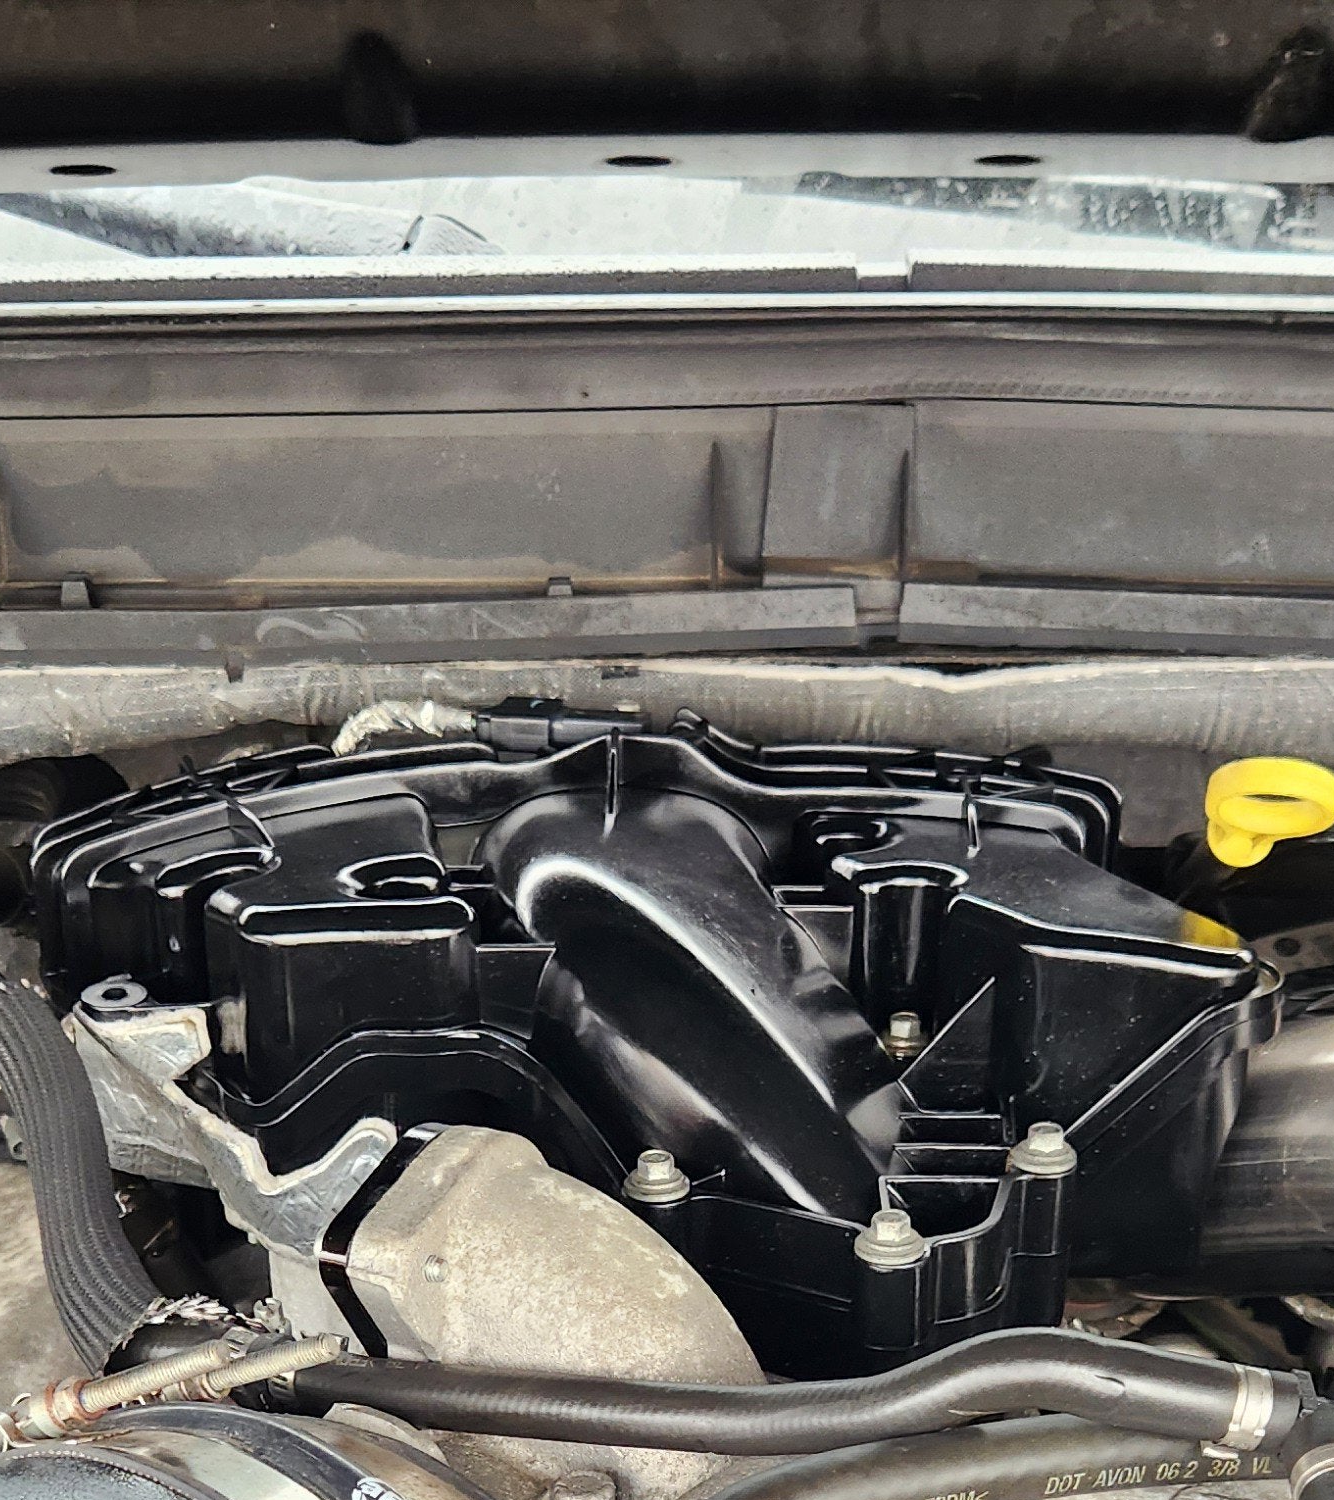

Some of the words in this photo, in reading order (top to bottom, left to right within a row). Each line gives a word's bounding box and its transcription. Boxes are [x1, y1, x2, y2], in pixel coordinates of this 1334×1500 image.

[1045, 1472, 1086, 1495] DOT
[1092, 1464, 1147, 1489] AVON
[1207, 1457, 1240, 1477] 3/8
